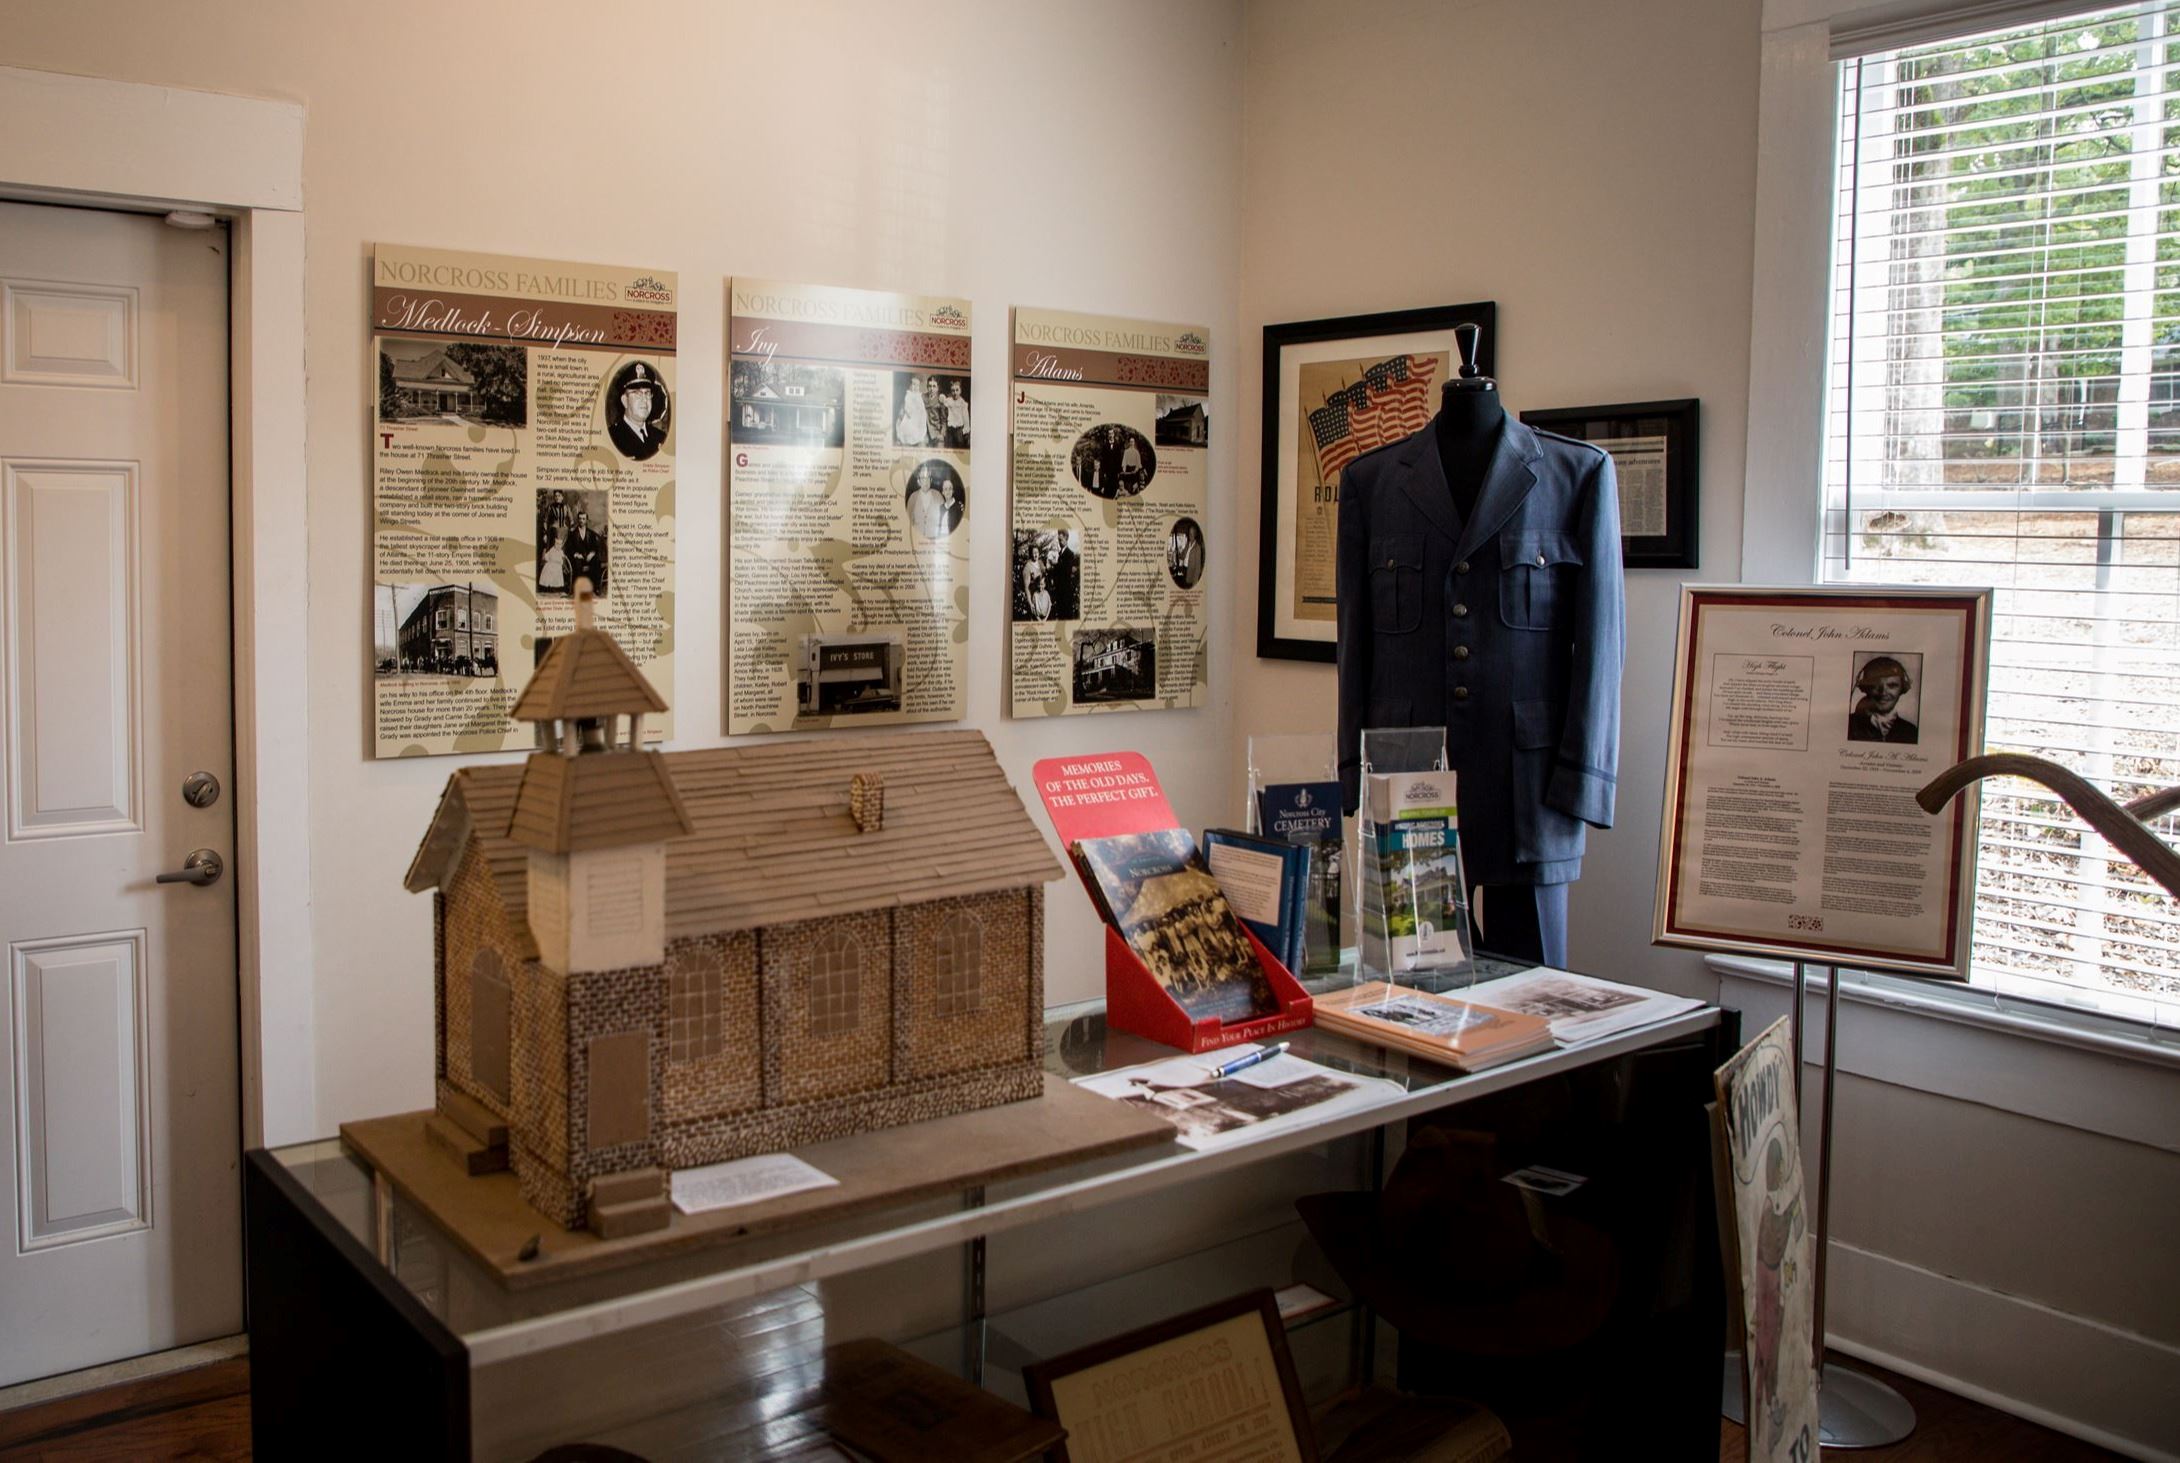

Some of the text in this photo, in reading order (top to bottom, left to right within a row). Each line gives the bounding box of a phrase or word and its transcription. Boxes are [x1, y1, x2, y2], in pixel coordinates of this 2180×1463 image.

[380, 260, 618, 300] NORCROSS FAMILIES
[627, 290, 670, 301] NORCROSS
[736, 294, 924, 326] NORCROSS FAMILIES
[931, 317, 966, 326] NORCROSS
[1018, 323, 1170, 352] NORCROSS FAMILIES
[1176, 344, 1205, 352] NORCROSS
[1020, 352, 1084, 380] Adams
[1770, 624, 1890, 640] Colonel John Adams
[830, 652, 874, 662] IVY'S STORE
[1061, 760, 1123, 776] MEMORIES
[1046, 772, 1149, 792] OF THE OLD DAYS.
[1049, 786, 1158, 808] THE PERFECT GIFT.
[1279, 808, 1326, 819] Norcross City
[1274, 817, 1331, 832] CEMETERY
[1402, 831, 1445, 849] HOMES
